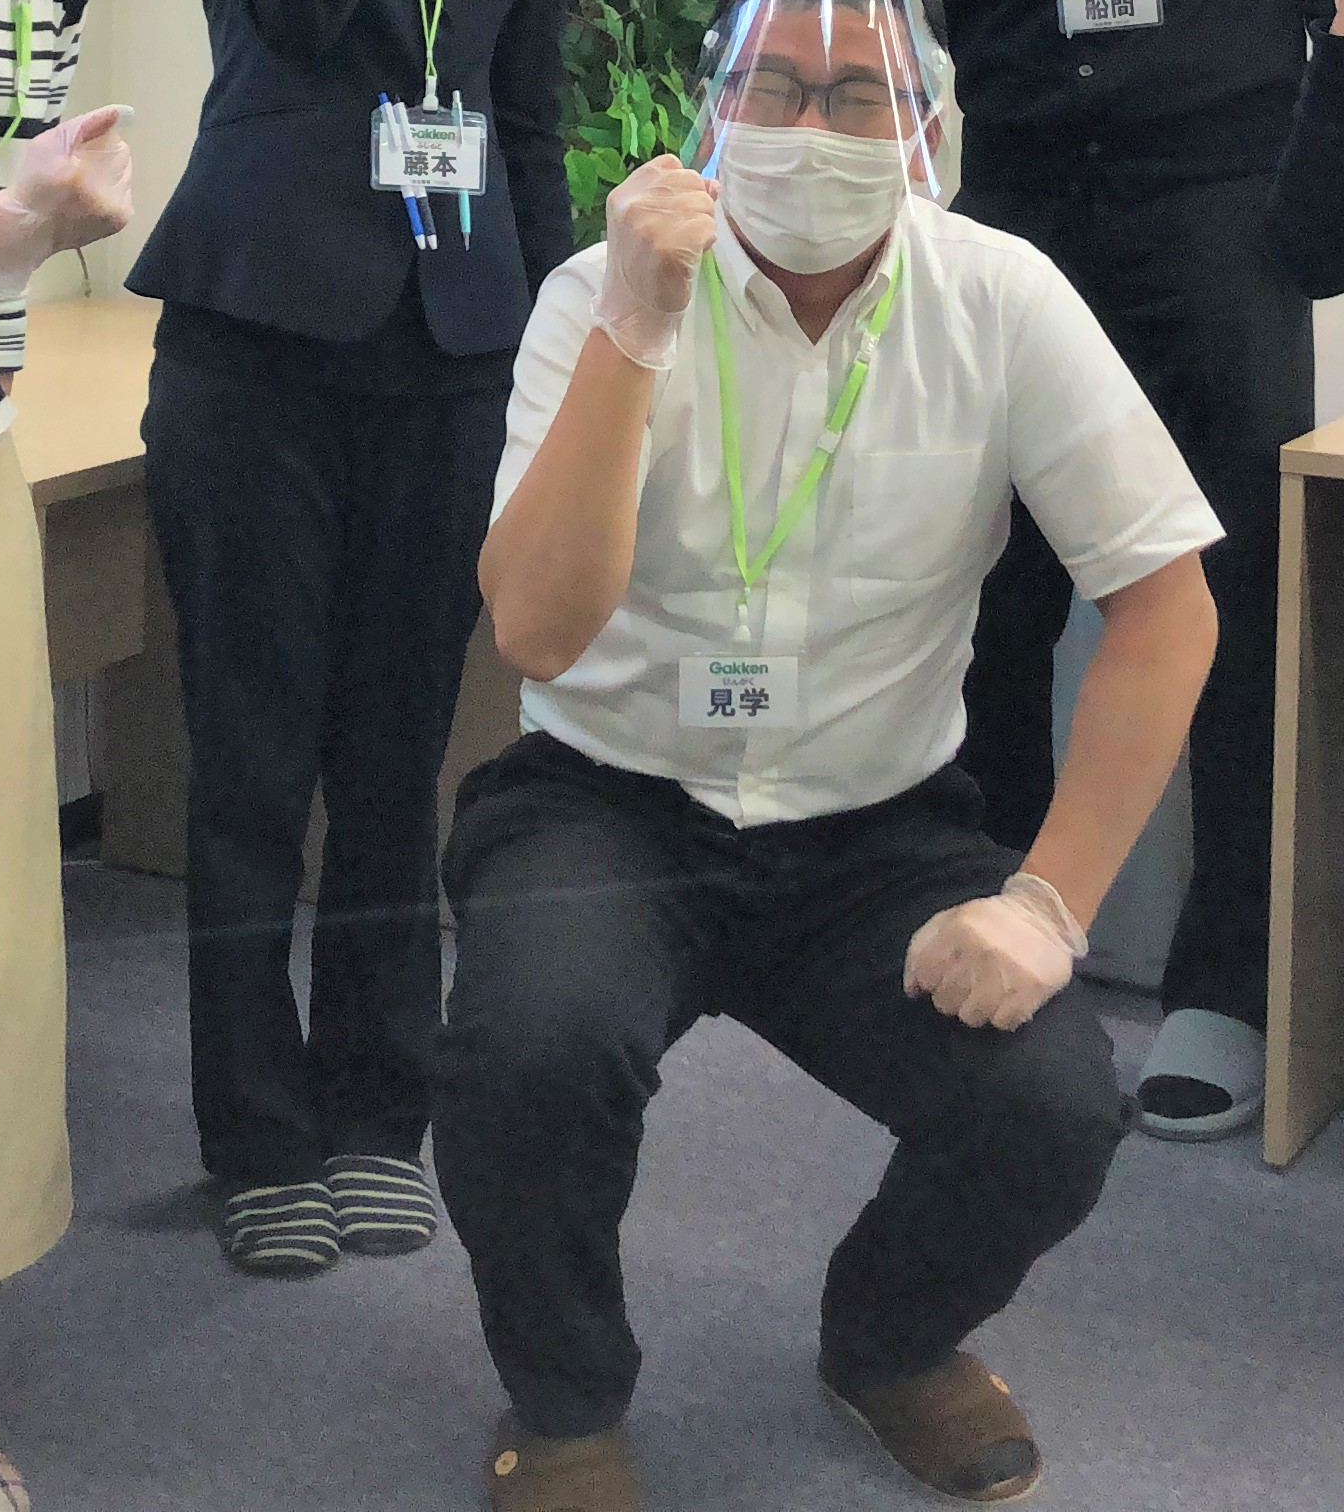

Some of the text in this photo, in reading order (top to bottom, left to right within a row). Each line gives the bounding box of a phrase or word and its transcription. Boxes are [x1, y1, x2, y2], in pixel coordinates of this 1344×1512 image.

[402, 150, 457, 178] 藤本
[708, 661, 769, 675] Gakken
[706, 687, 770, 717] 見学
